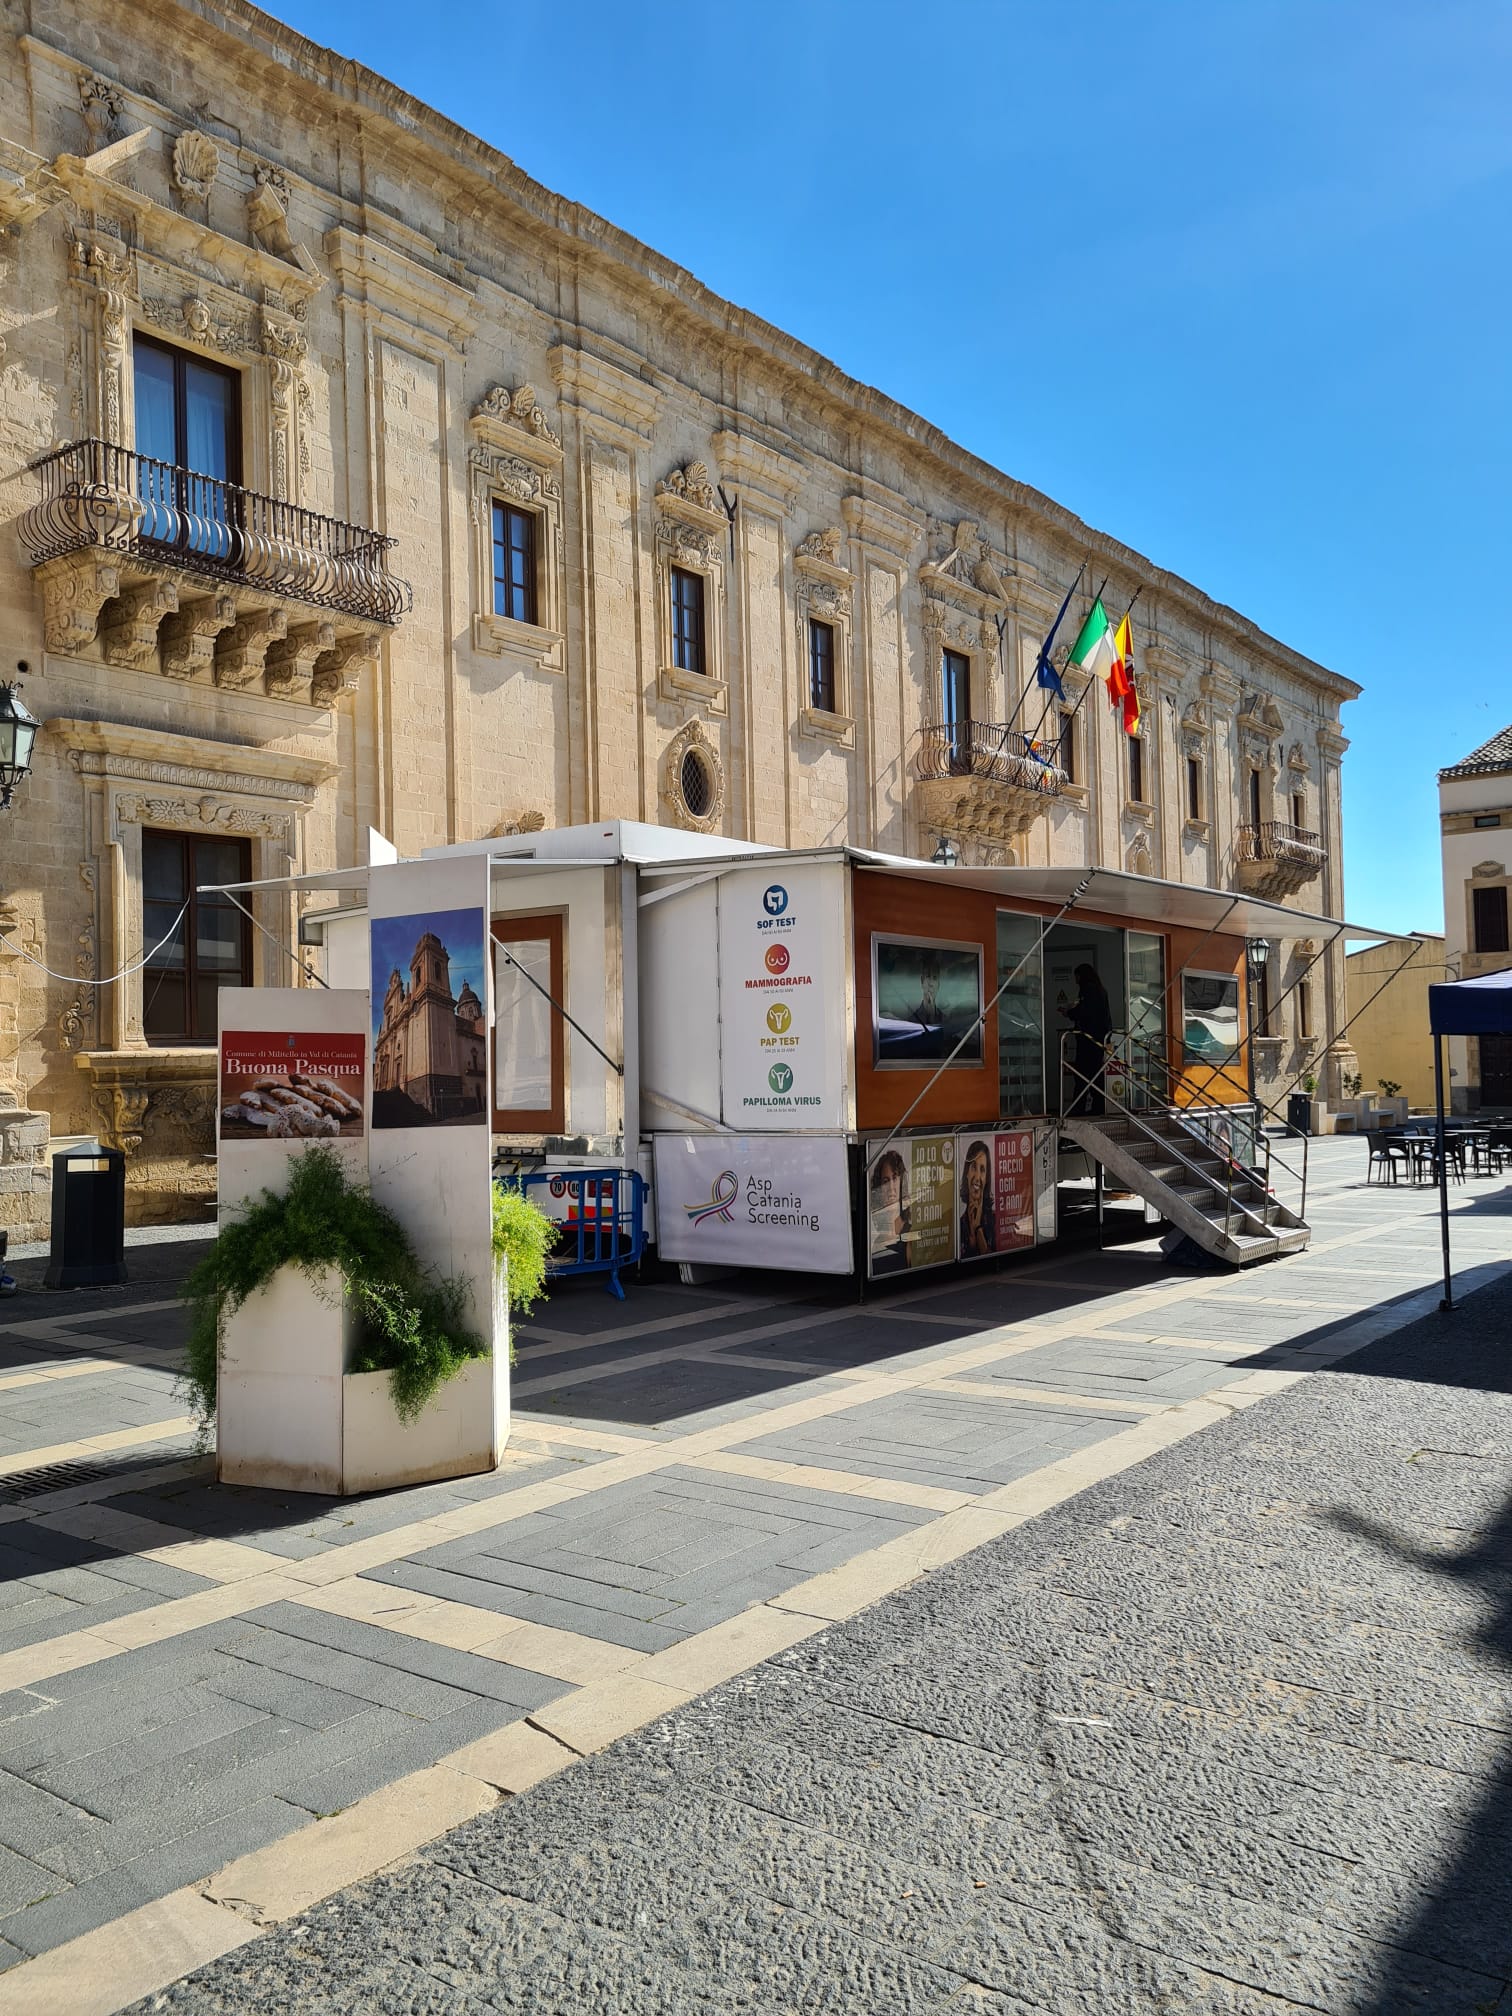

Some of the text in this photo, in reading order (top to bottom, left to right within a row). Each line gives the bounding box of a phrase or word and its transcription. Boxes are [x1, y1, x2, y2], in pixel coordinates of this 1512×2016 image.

[757, 917, 796, 929] SOF TEST
[745, 976, 812, 989] MAMMOGRAFIA
[760, 1036, 800, 1047] PAP TEST
[225, 1049, 357, 1059] Comune di Militello in Val di Catania
[225, 1058, 361, 1079] Buona Pasqua
[743, 1096, 821, 1106] PAPILLOMA VIRUS
[927, 1146, 937, 1162] LO
[998, 1140, 1016, 1157] IO LO
[916, 1165, 944, 1184] FACCIO
[999, 1158, 1023, 1175] FACCIO
[554, 1182, 562, 1192] 70
[746, 1175, 772, 1195] Asp
[999, 1177, 1016, 1193] OGNI
[747, 1191, 802, 1209] Catania
[999, 1194, 1022, 1211] 2 ANNI
[748, 1208, 820, 1232] Screening
[916, 1204, 942, 1224] 3 ANNI
